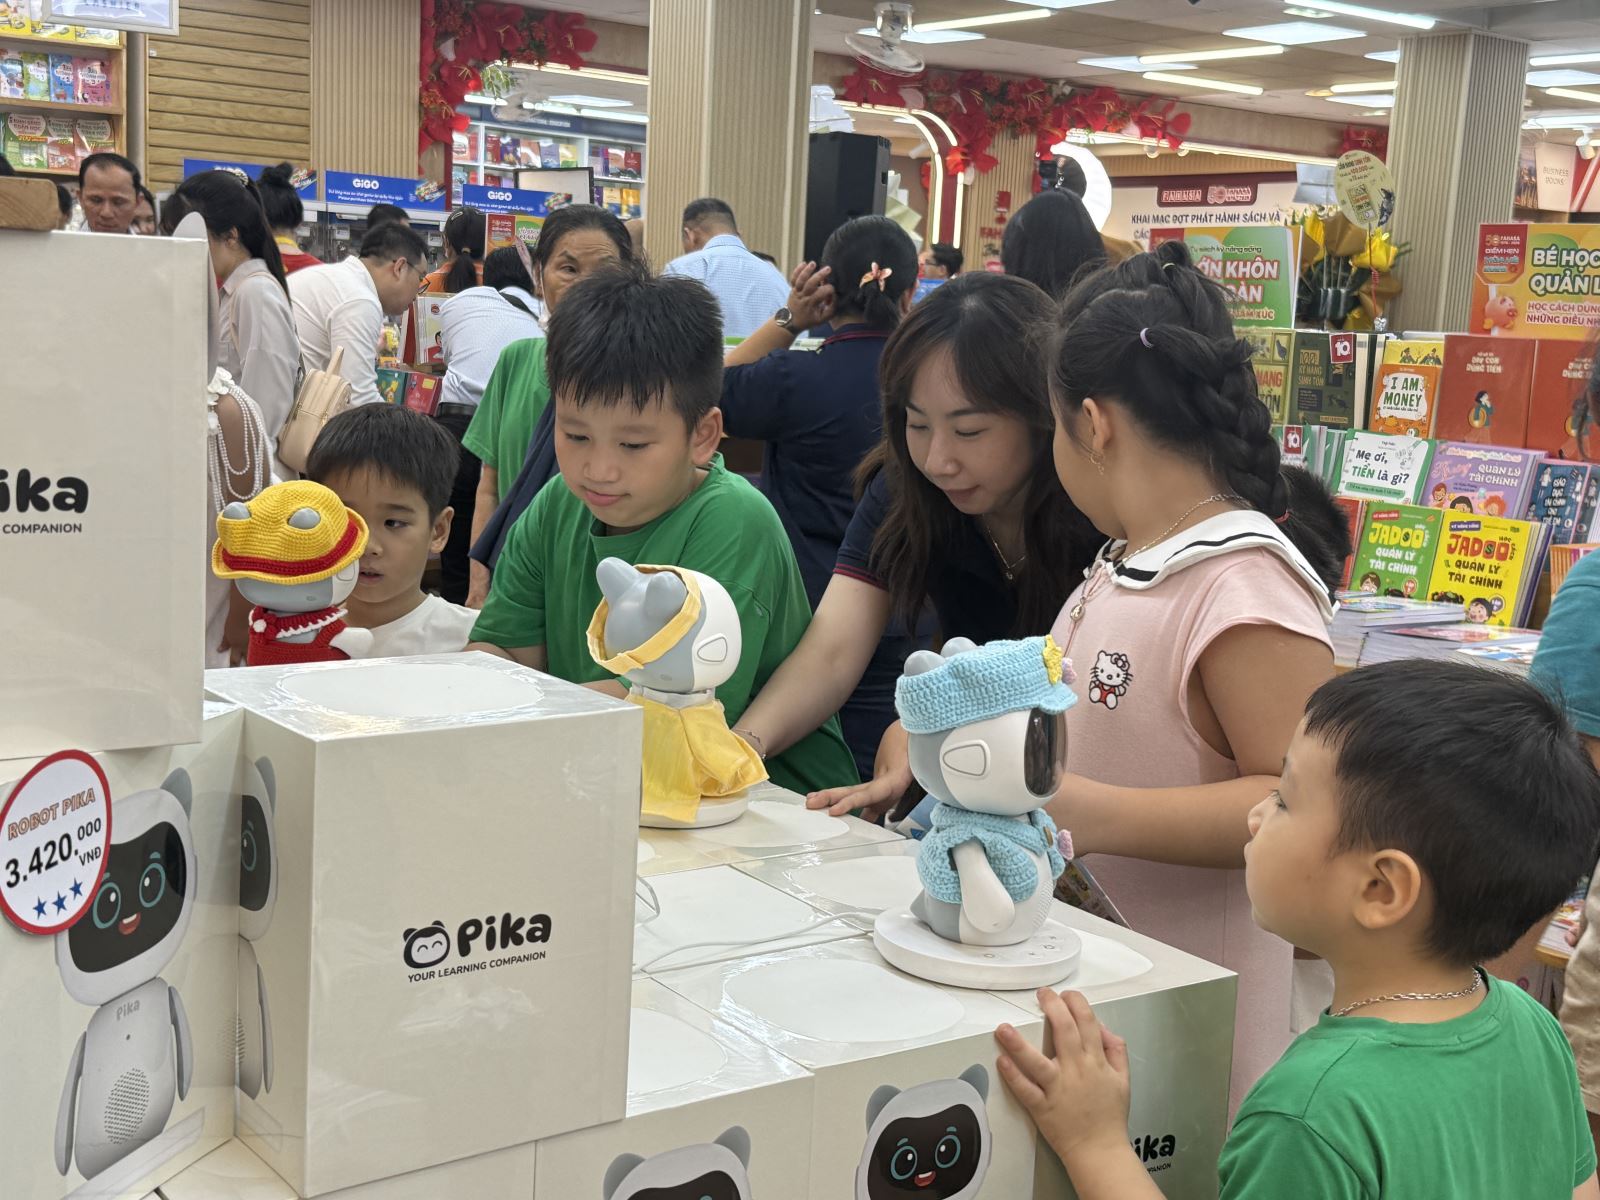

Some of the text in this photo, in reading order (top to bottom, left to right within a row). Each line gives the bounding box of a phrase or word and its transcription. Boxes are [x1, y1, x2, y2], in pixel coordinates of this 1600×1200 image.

[1162, 189, 1202, 202] FAHASA
[1132, 210, 1280, 225] KHAI MẠC ĐỢT PHÁT HÀNH SÁCH VÀ
[1134, 230, 1149, 240] CÁC
[1198, 256, 1278, 278] ỚN KHÔN
[1534, 245, 1557, 265] BÉ
[1561, 249, 1600, 272] HỌC
[1530, 270, 1589, 295] QUẢN
[1528, 302, 1548, 312] HỌC
[1550, 304, 1575, 312] CÁCH
[1527, 314, 1560, 324] NHỮNG
[1562, 314, 1584, 324] ĐIỀU
[1334, 340, 1350, 356] 10
[1390, 377, 1420, 391] I AM
[1383, 392, 1422, 407] MONEY
[1356, 450, 1388, 464] Mẹ ơi,
[1352, 464, 1410, 486] TIỀN là gì?
[1486, 475, 1518, 486] CHÍNH
[0, 468, 88, 513] ika
[2, 523, 82, 534] COMPANION
[1368, 522, 1424, 549] JADOO
[1376, 546, 1416, 561] QUẢN LÝ
[1447, 534, 1510, 562] JADOO
[1369, 558, 1418, 576] TÀI CHÍNH
[1455, 558, 1500, 574] QUẢN LÝ
[1448, 570, 1503, 590] TÀI CHÍNH
[8, 788, 96, 841] ROBOT PIKA
[78, 846, 102, 867] VNĐ
[457, 912, 552, 958] Pika
[408, 950, 546, 983] YOUR LEARNING COMPANION
[116, 1000, 140, 1021] Pika
[1131, 1134, 1176, 1162] ika
